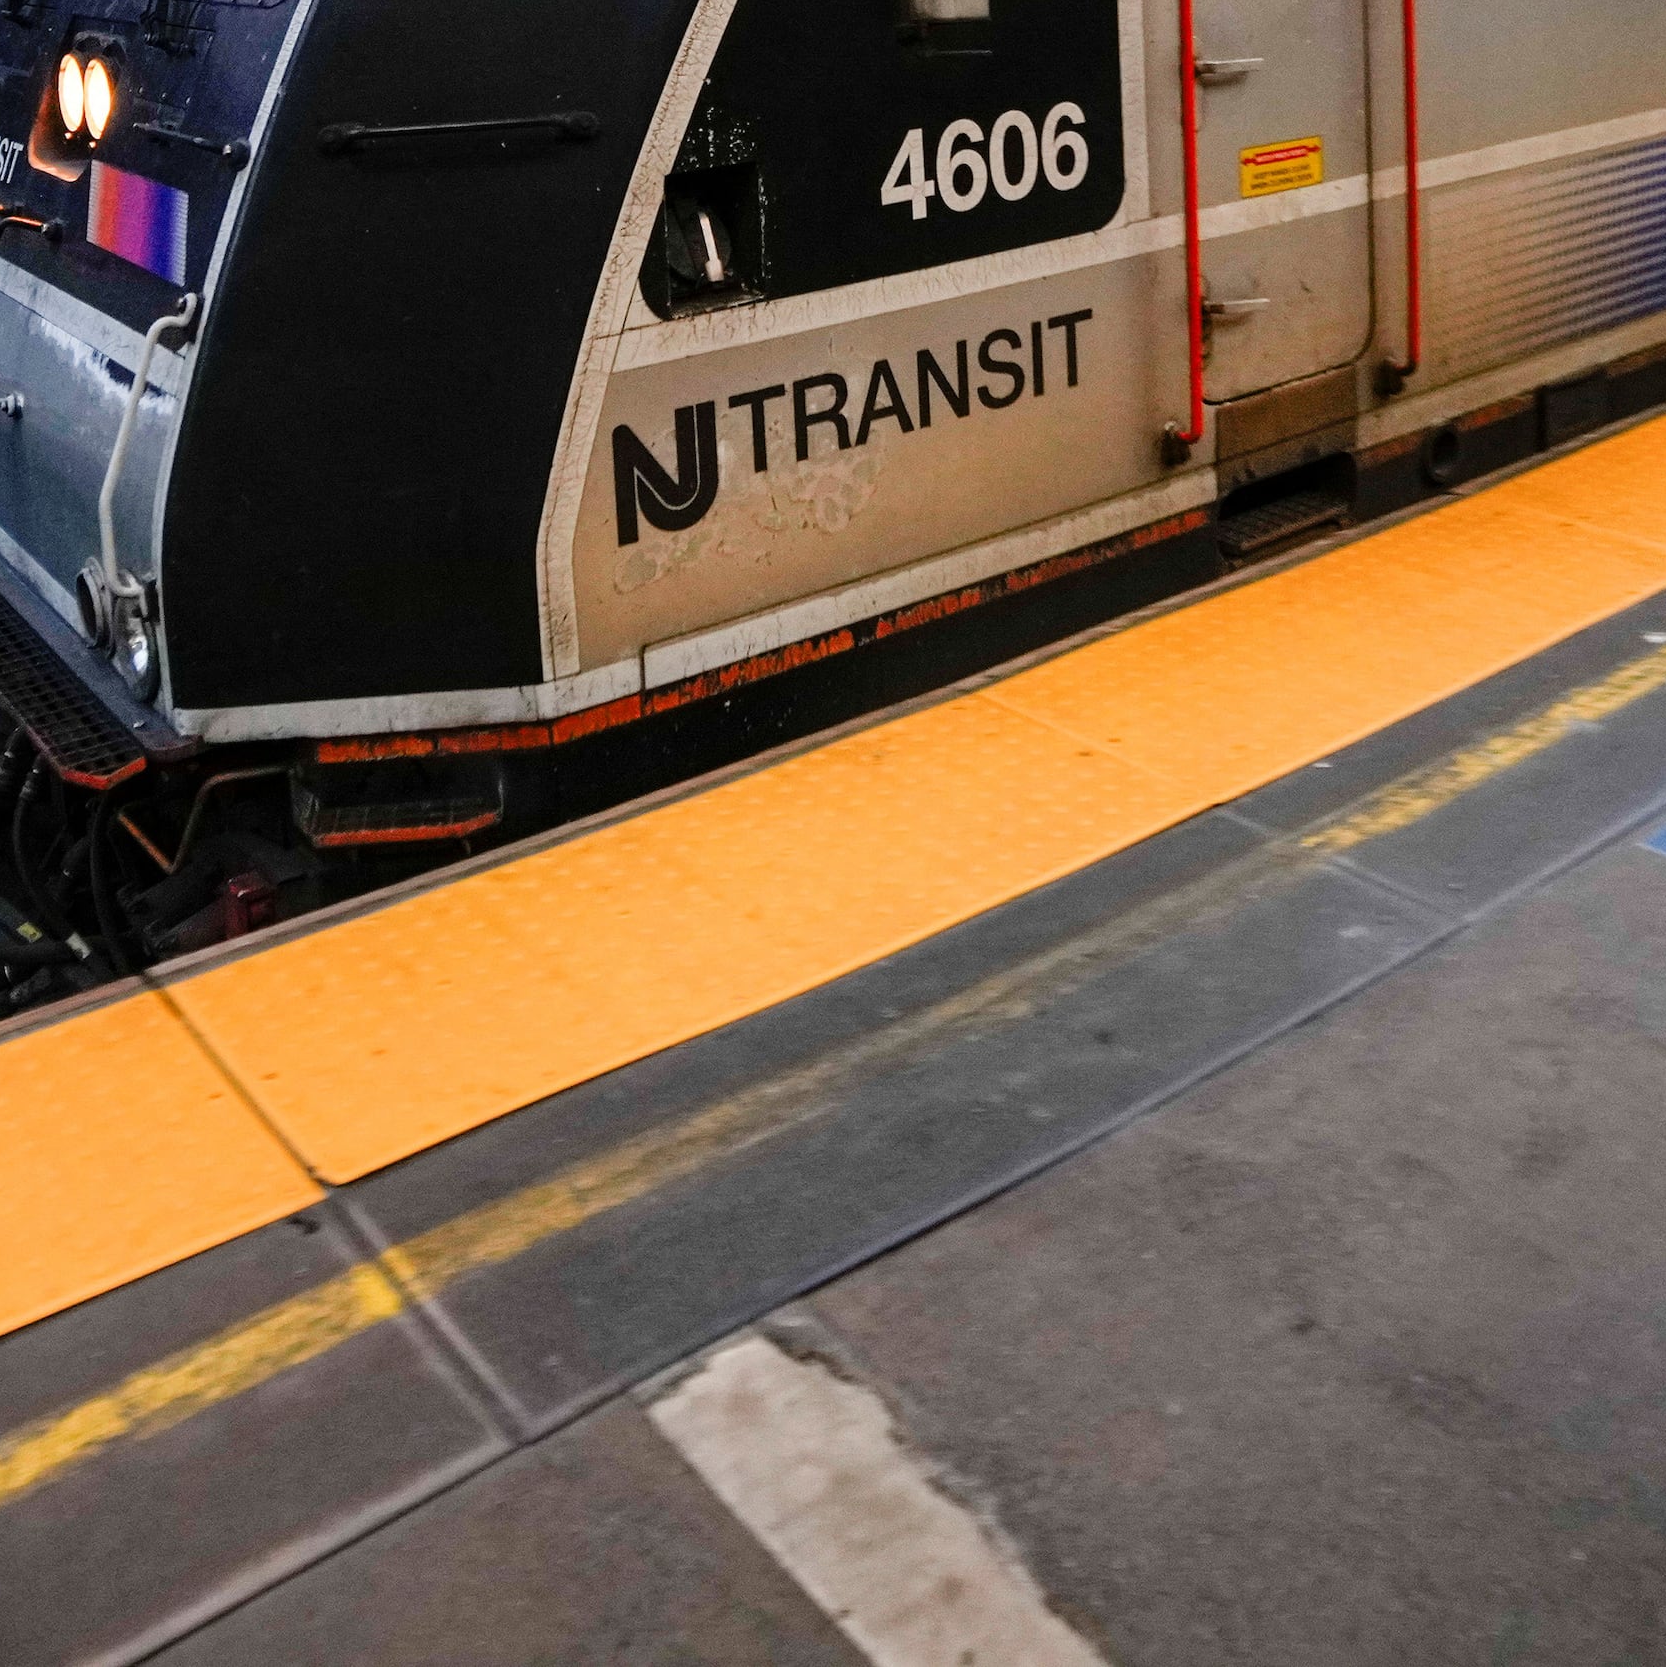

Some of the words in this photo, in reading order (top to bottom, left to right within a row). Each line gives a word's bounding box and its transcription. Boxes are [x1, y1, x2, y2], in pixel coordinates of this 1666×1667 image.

[880, 101, 1090, 221] 4606
[613, 401, 720, 546] NJ
[728, 308, 1093, 474] TRANSIT
